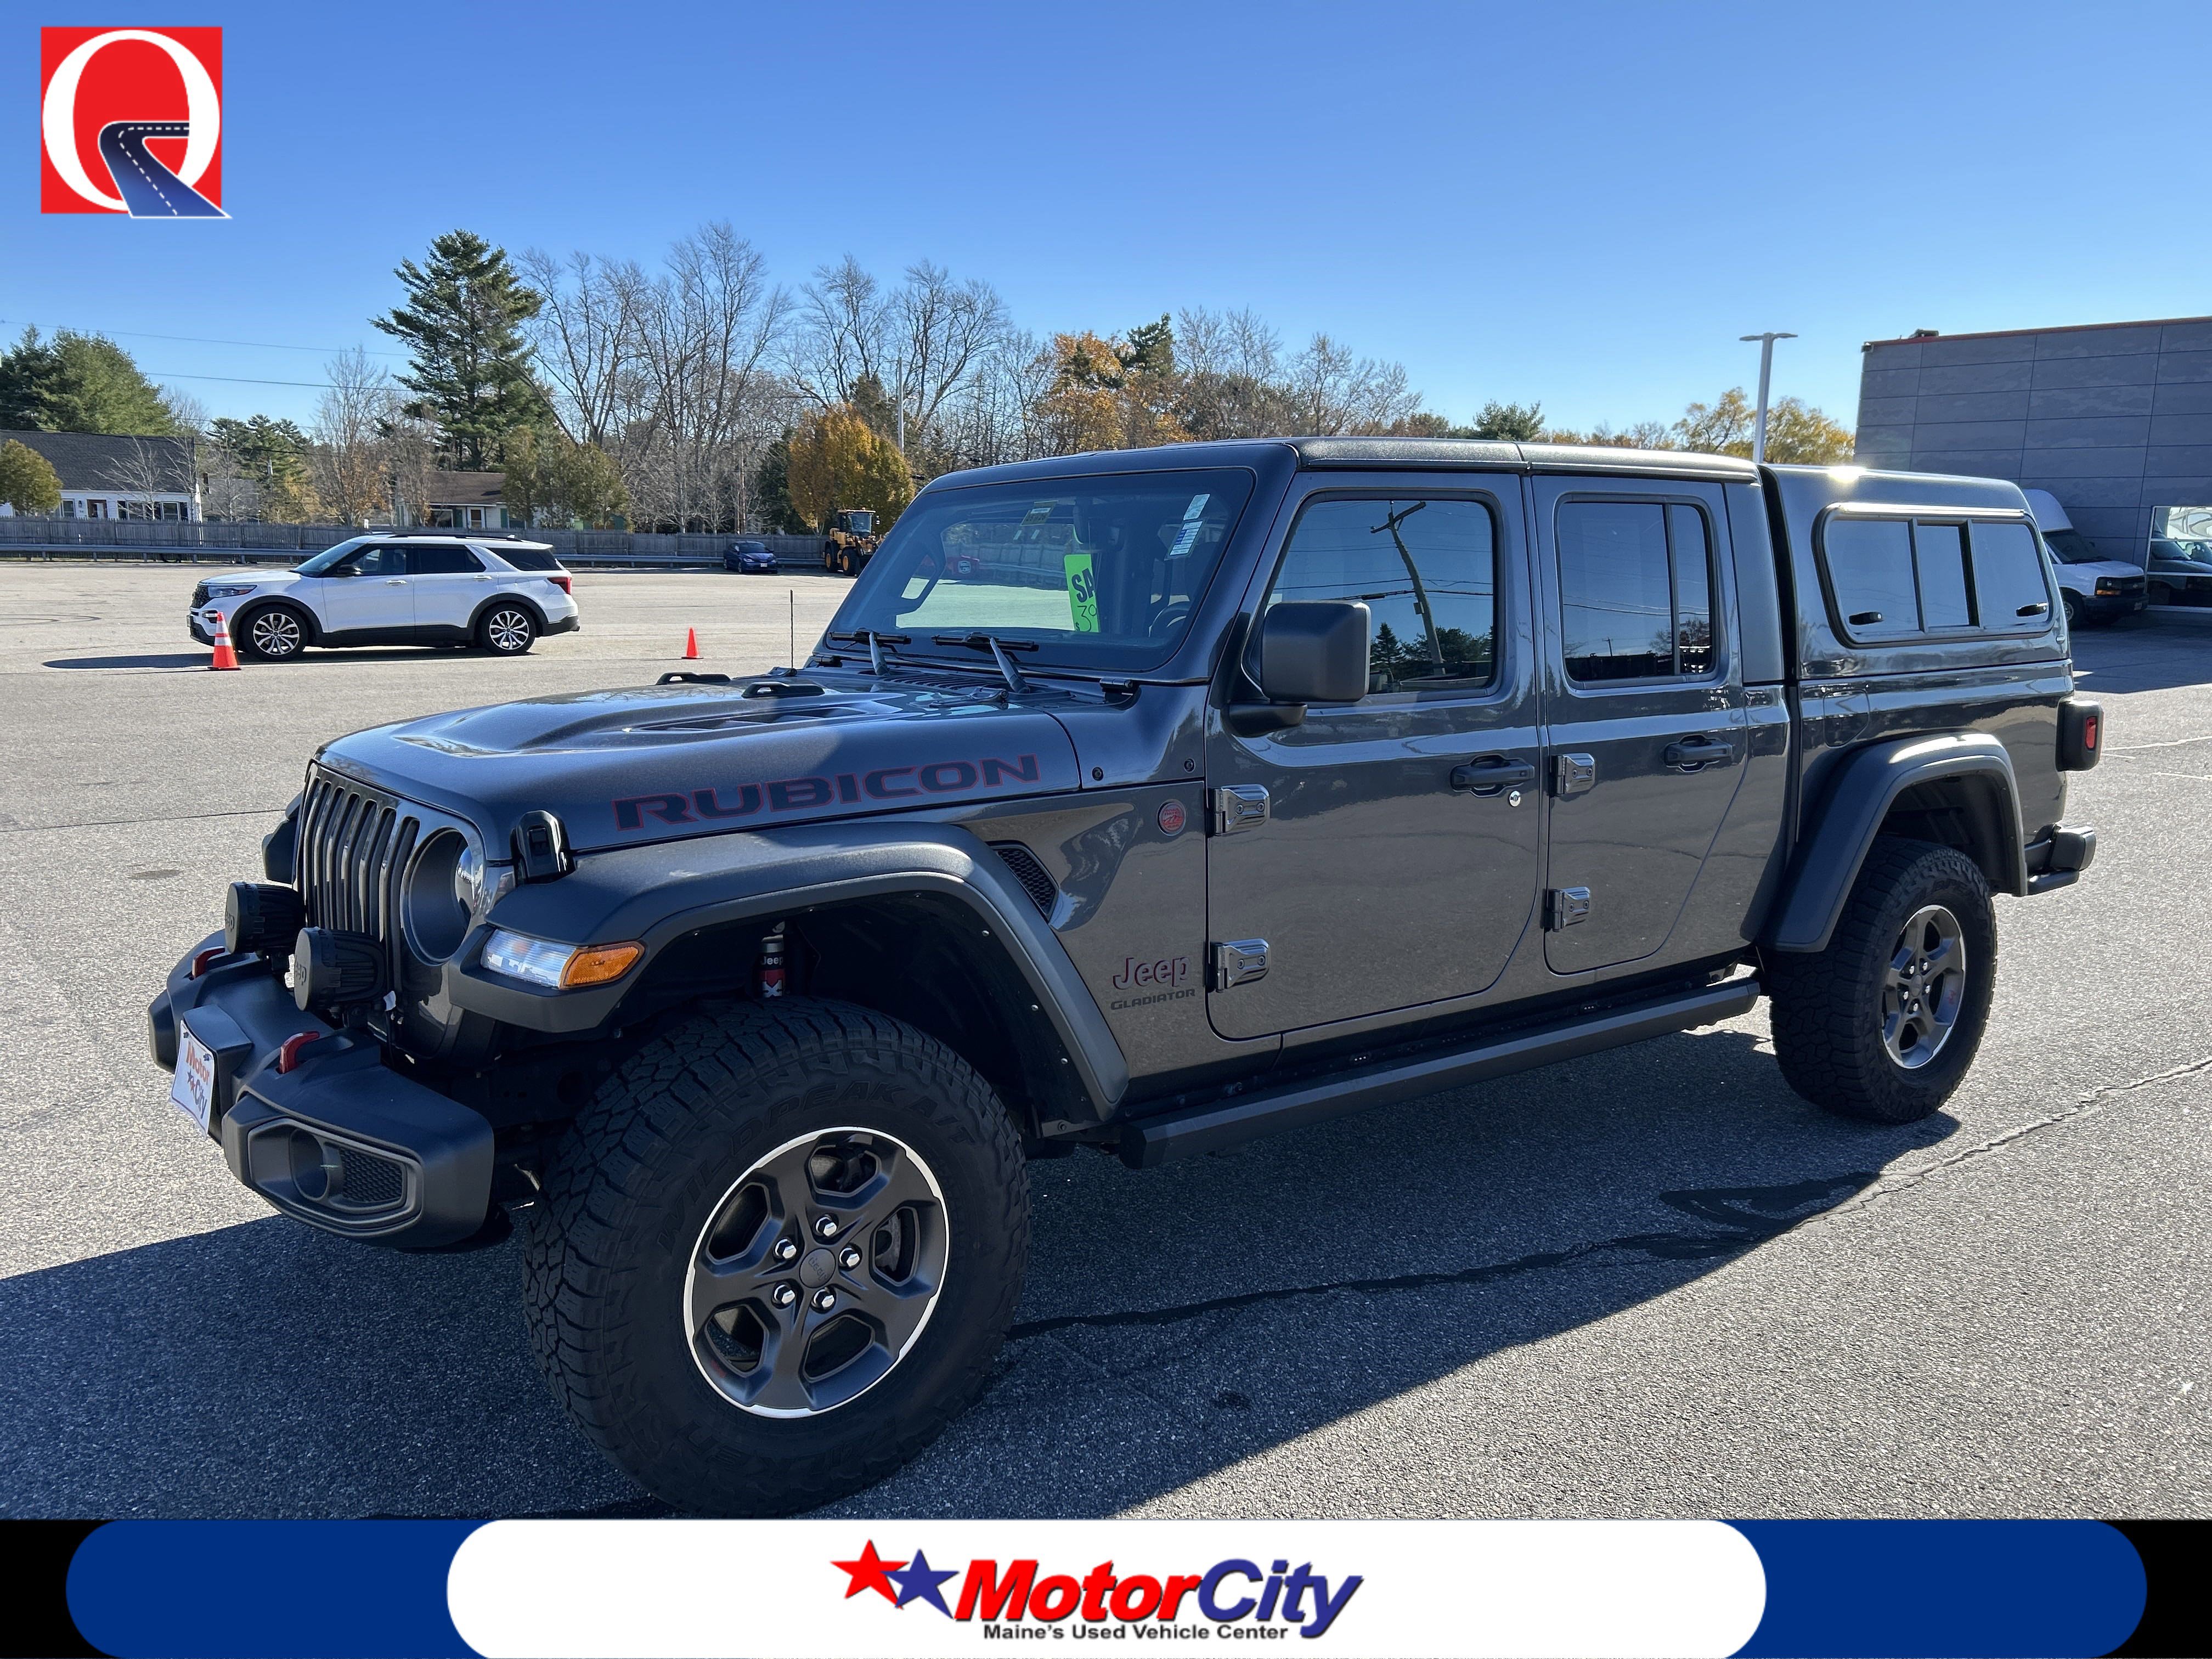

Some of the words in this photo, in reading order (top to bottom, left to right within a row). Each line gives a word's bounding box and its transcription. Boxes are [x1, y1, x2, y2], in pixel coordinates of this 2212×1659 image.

[611, 753, 1041, 831] RUBICON
[760, 956, 783, 966] Jeep
[1113, 957, 1192, 990] Jeep
[1111, 989, 1195, 1010] GLADIATOR
[186, 1041, 210, 1085] Motor
[194, 1079, 207, 1119] City
[658, 1080, 906, 1252] WILDPEAK
[808, 1257, 828, 1281] Jeep
